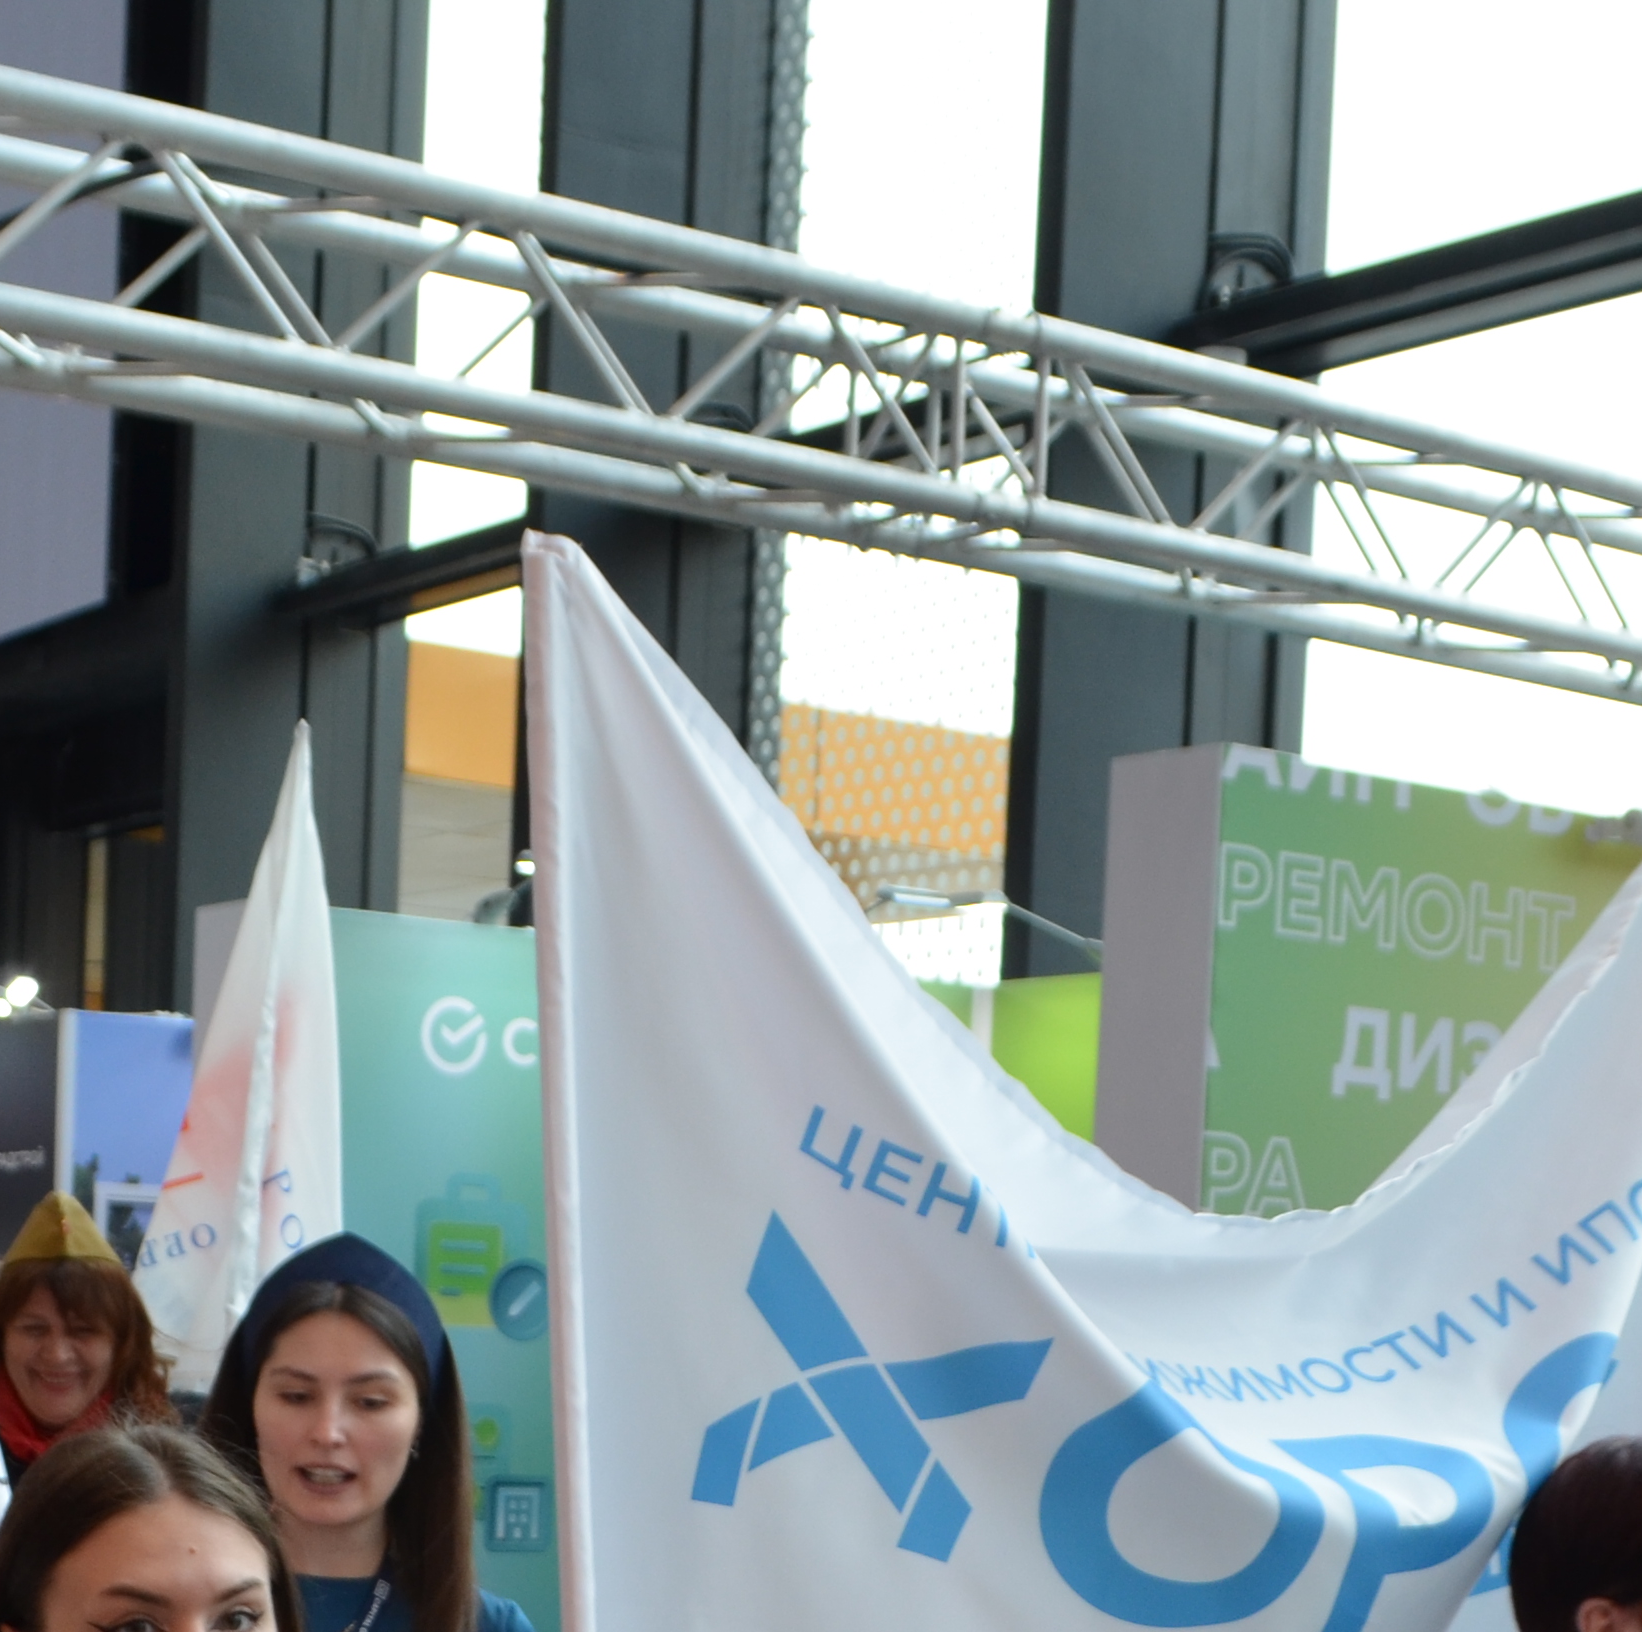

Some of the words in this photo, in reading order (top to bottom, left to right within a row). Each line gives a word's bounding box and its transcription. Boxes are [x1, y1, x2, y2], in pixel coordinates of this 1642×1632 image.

[1217, 840, 1576, 975] РЕМОНТ
[798, 1103, 1037, 1260] ЦЕН
[1469, 1276, 1538, 1329] И
